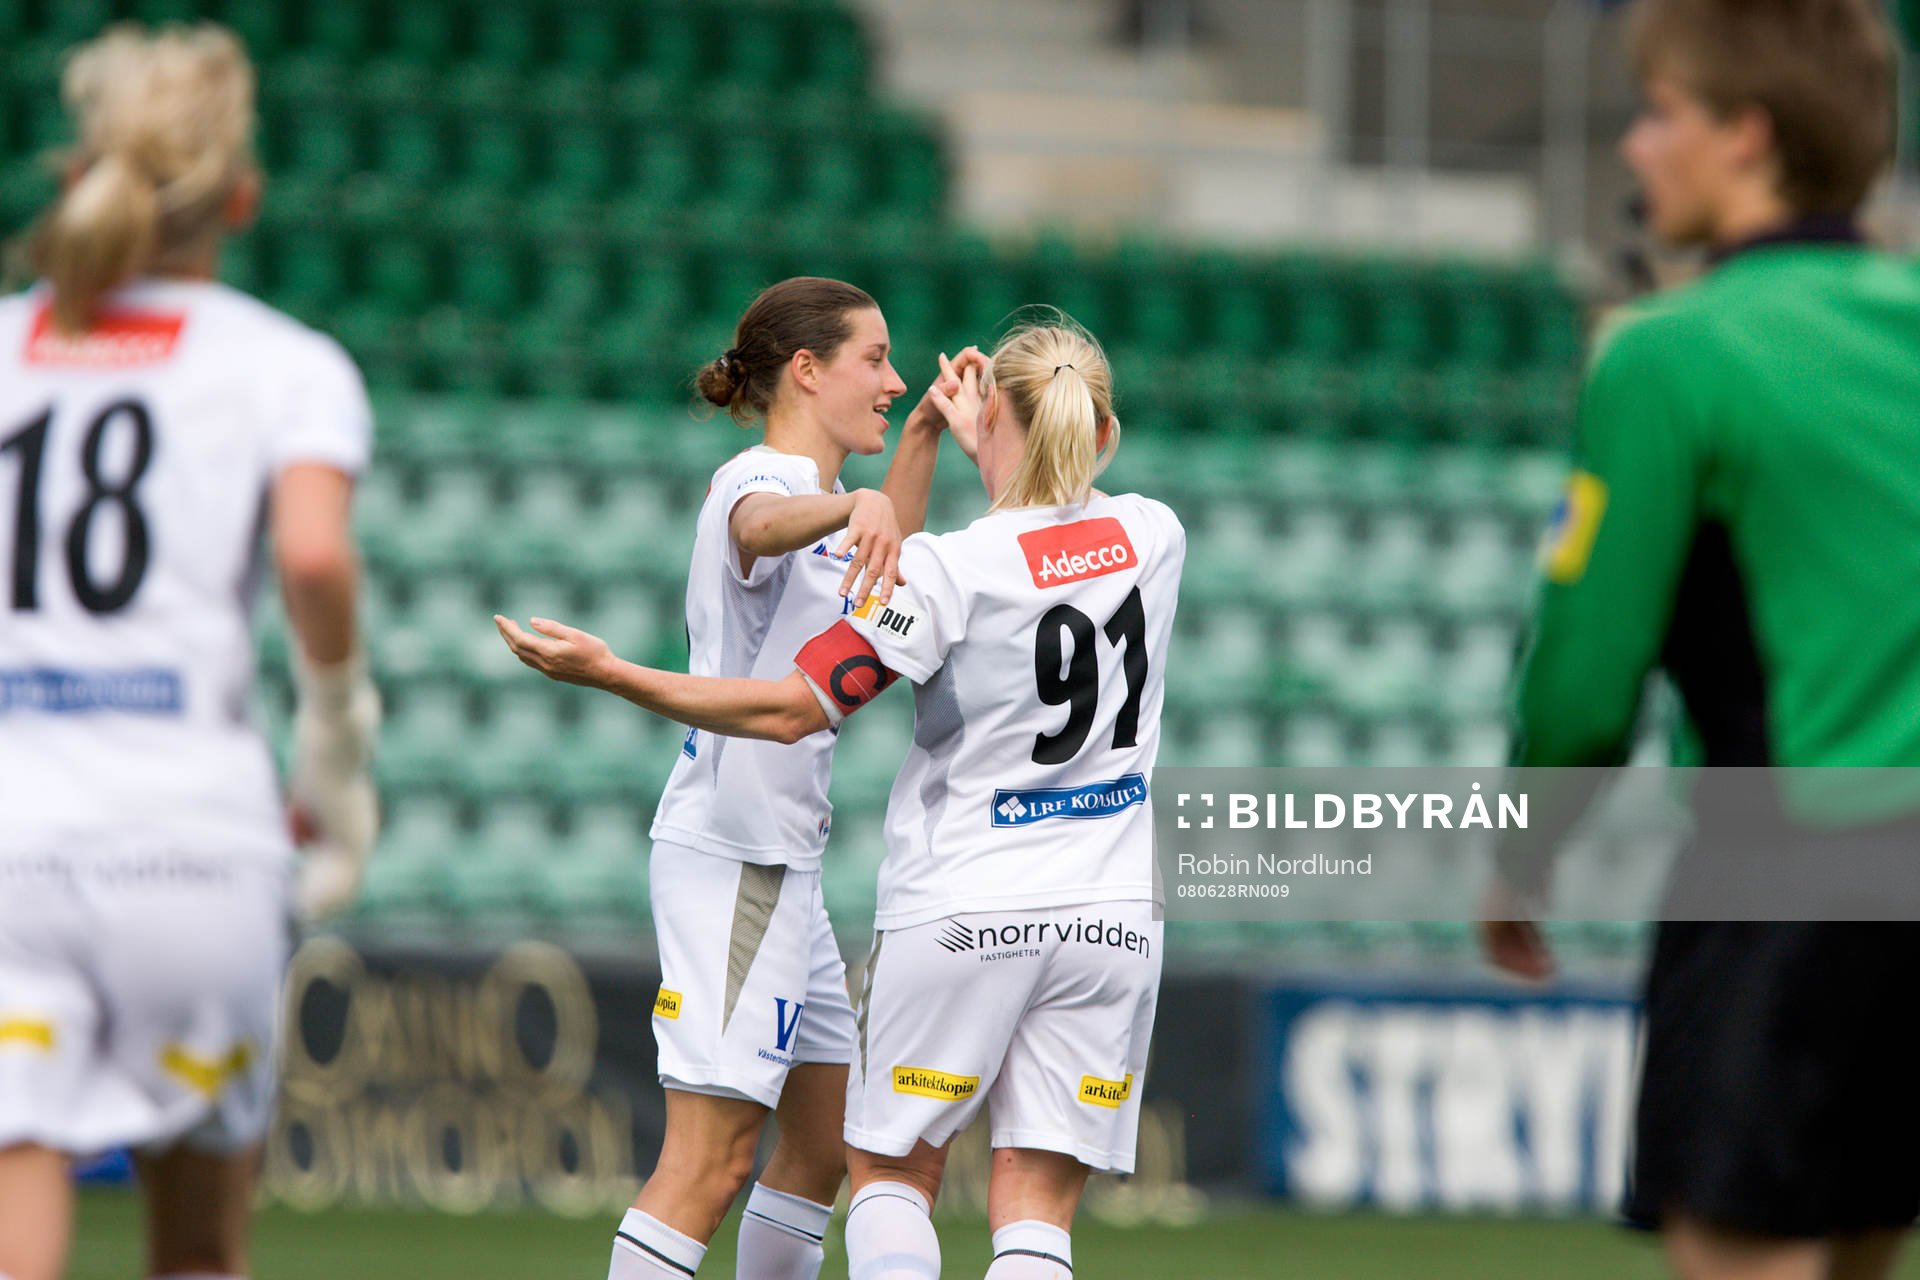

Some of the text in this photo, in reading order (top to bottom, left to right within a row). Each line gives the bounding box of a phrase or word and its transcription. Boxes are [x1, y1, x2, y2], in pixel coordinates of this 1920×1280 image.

[0, 396, 153, 616] 18
[1038, 544, 1127, 581] Adecco
[829, 654, 888, 706] C
[1031, 584, 1148, 765] 91
[1029, 784, 1142, 818] LRF KONSULT
[978, 917, 1150, 959] norrvidden
[980, 949, 1041, 963] FASTIGHETER
[897, 1073, 974, 1097] arkitektkopia
